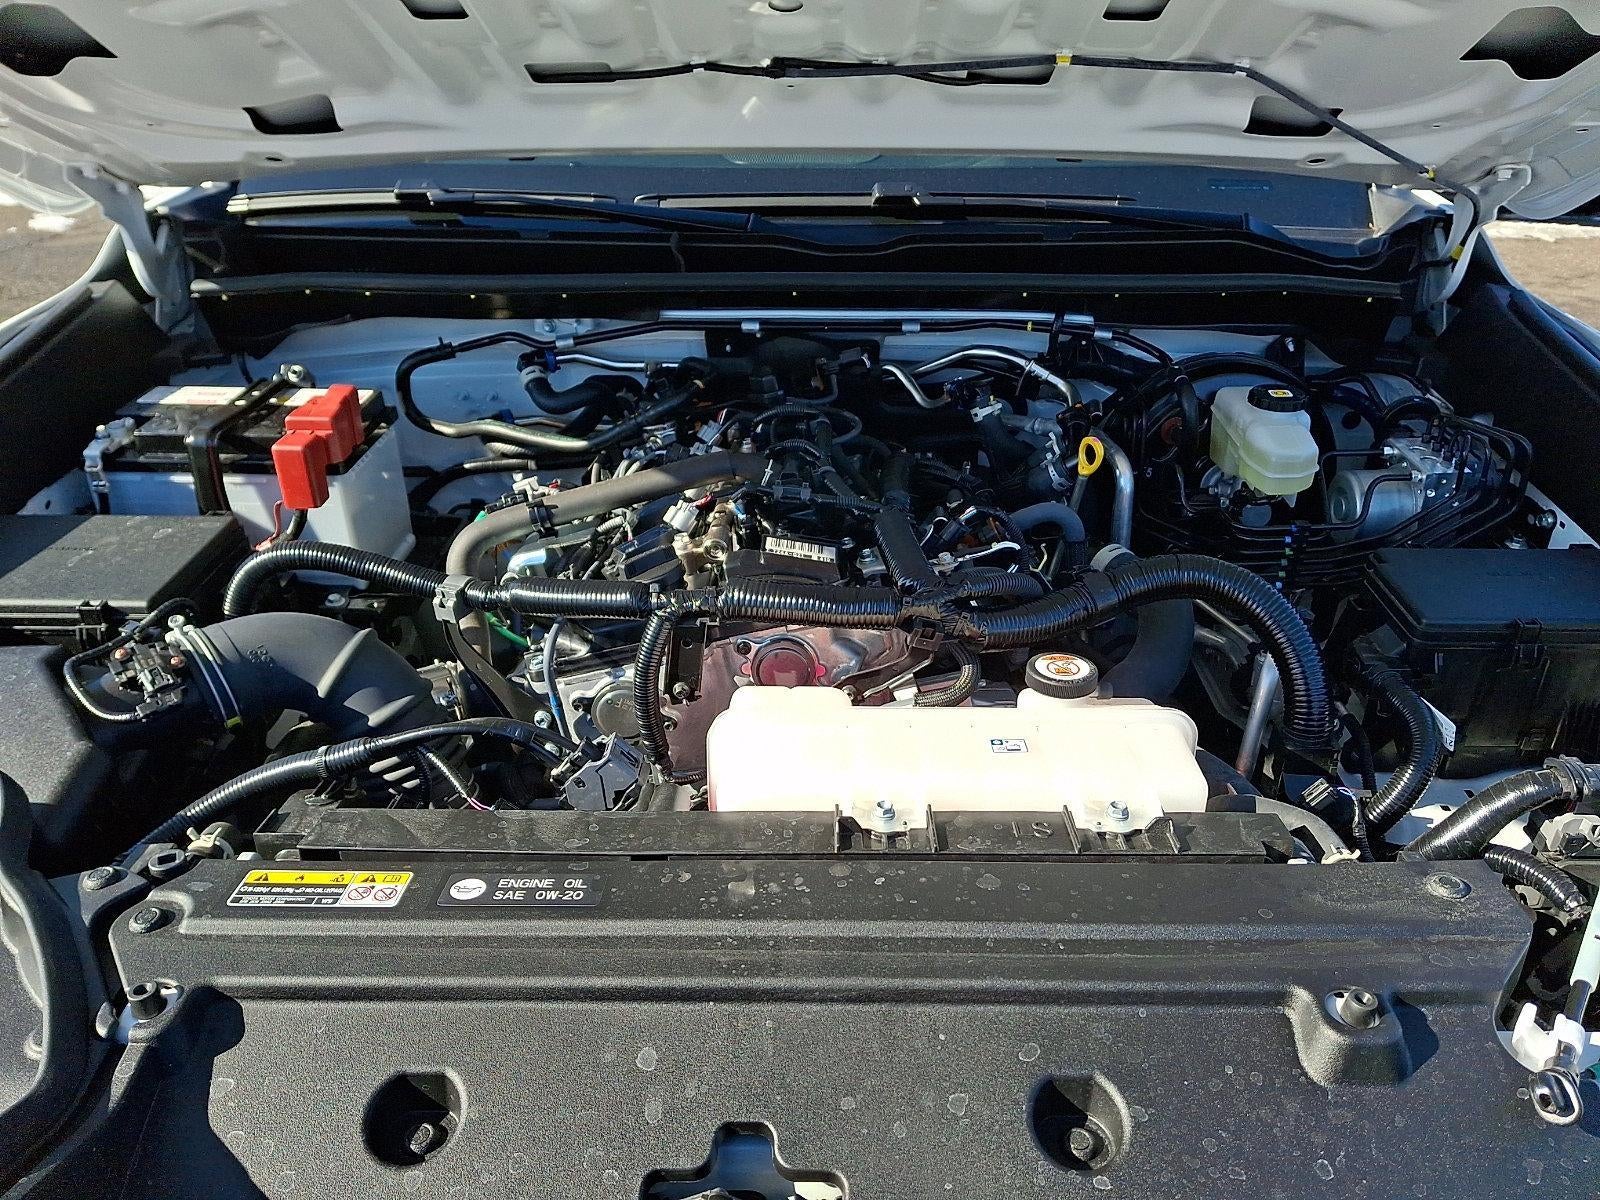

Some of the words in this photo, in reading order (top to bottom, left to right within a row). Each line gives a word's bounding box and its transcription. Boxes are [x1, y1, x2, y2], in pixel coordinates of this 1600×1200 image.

[497, 878, 556, 888] ENGINE
[563, 878, 588, 888] OIL
[492, 890, 527, 900] SAE
[535, 890, 585, 900] 0W-20
